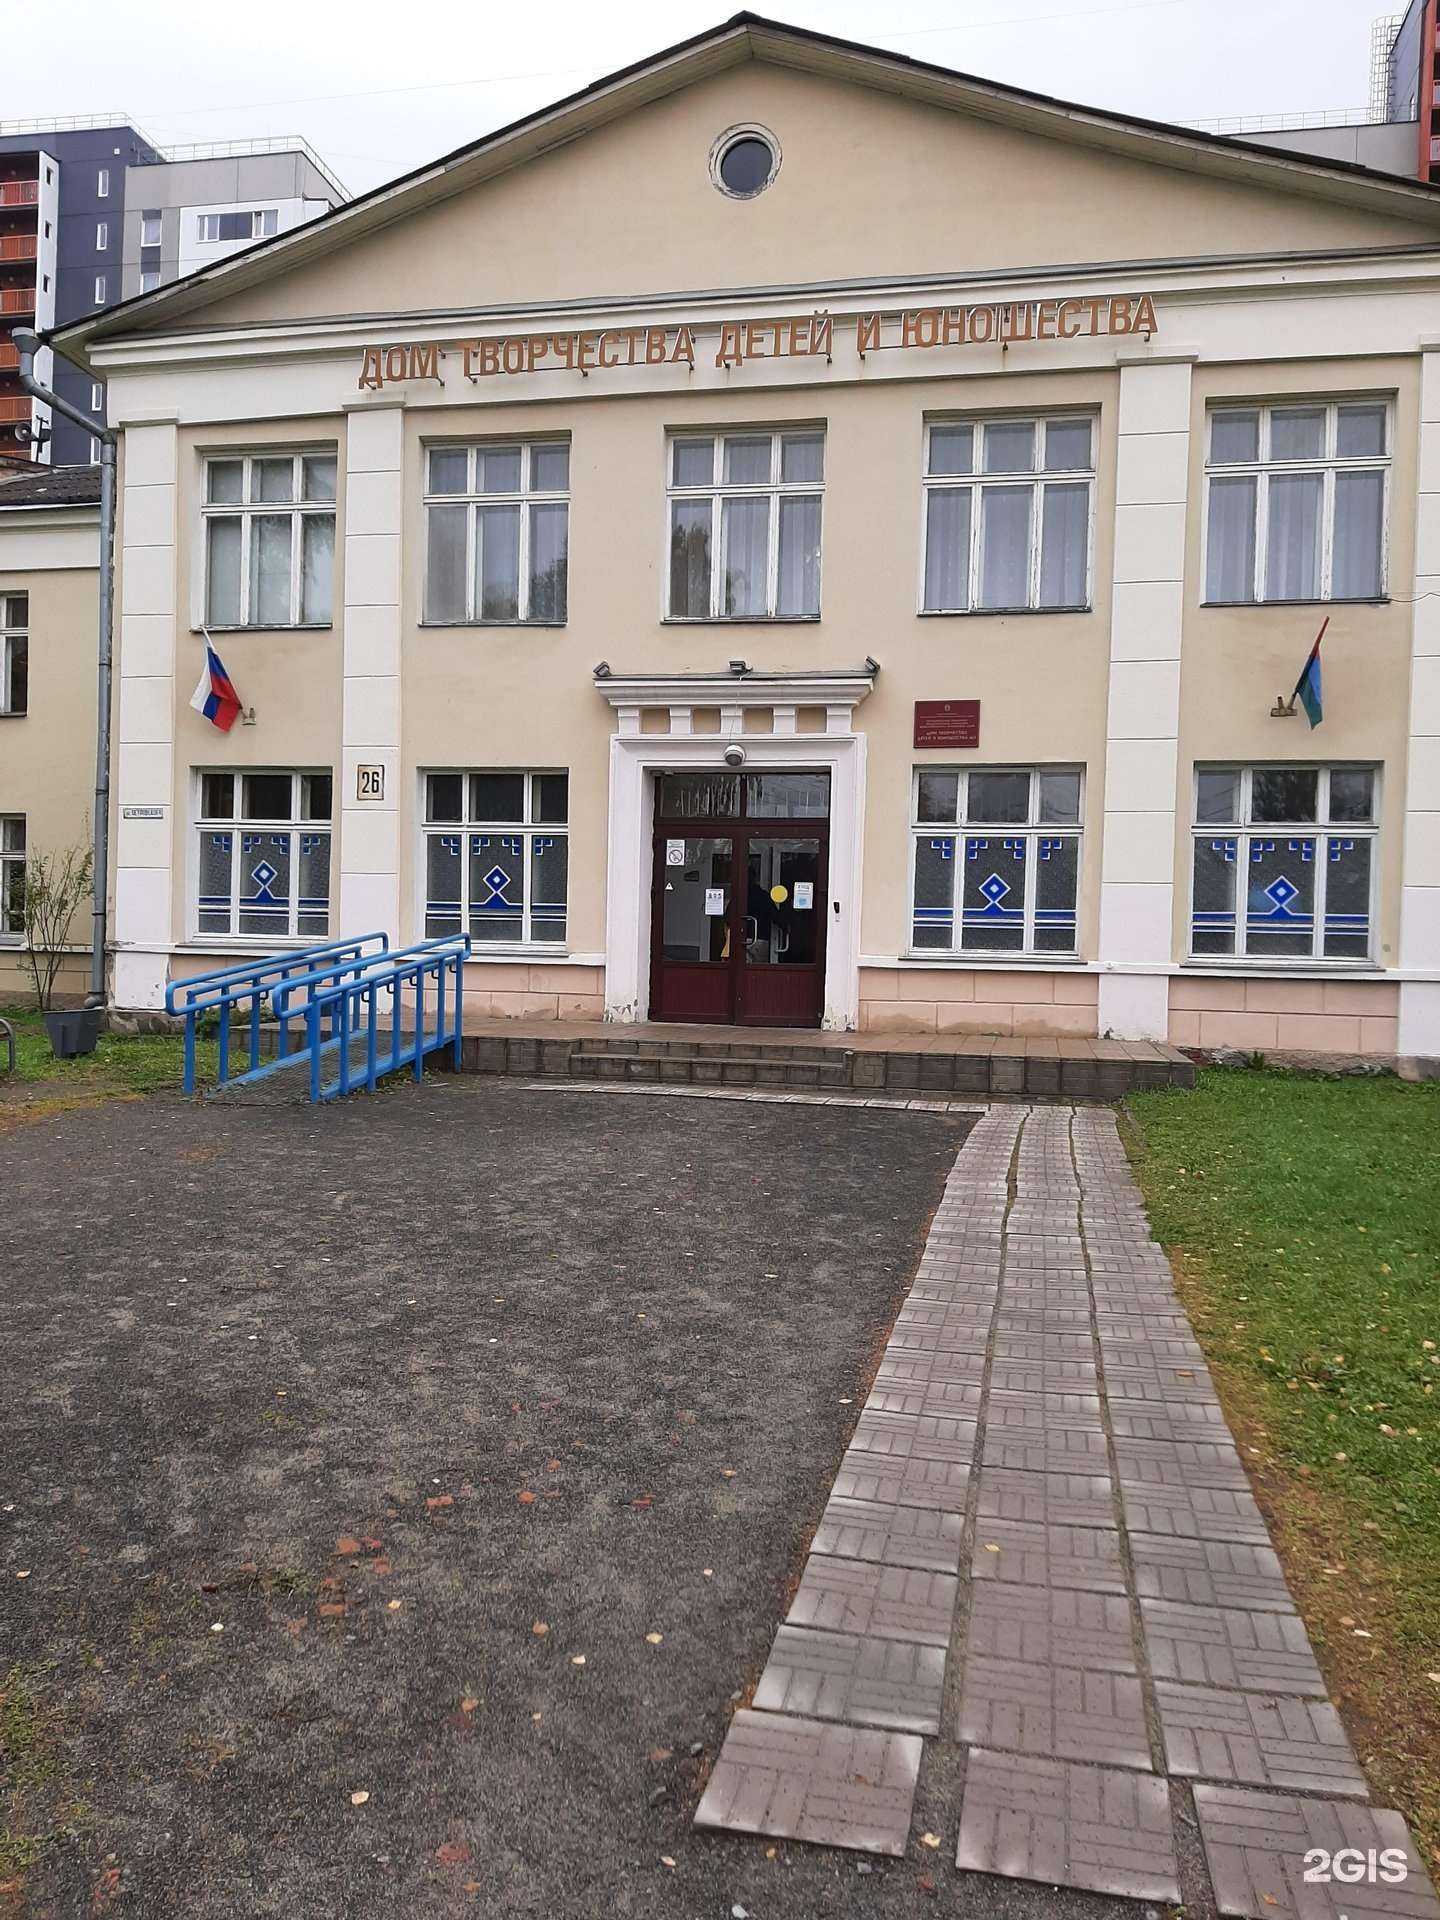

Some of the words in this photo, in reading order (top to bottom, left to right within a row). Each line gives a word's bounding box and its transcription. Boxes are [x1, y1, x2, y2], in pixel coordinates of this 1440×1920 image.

[359, 344, 440, 390] ДОМ
[456, 327, 696, 377] ТВОРЧЕСТВА
[715, 309, 834, 368] ДЕТЕЙ
[857, 311, 882, 353] И
[900, 295, 1159, 349] ЮНОШЕСТВА
[362, 771, 379, 793] 26
